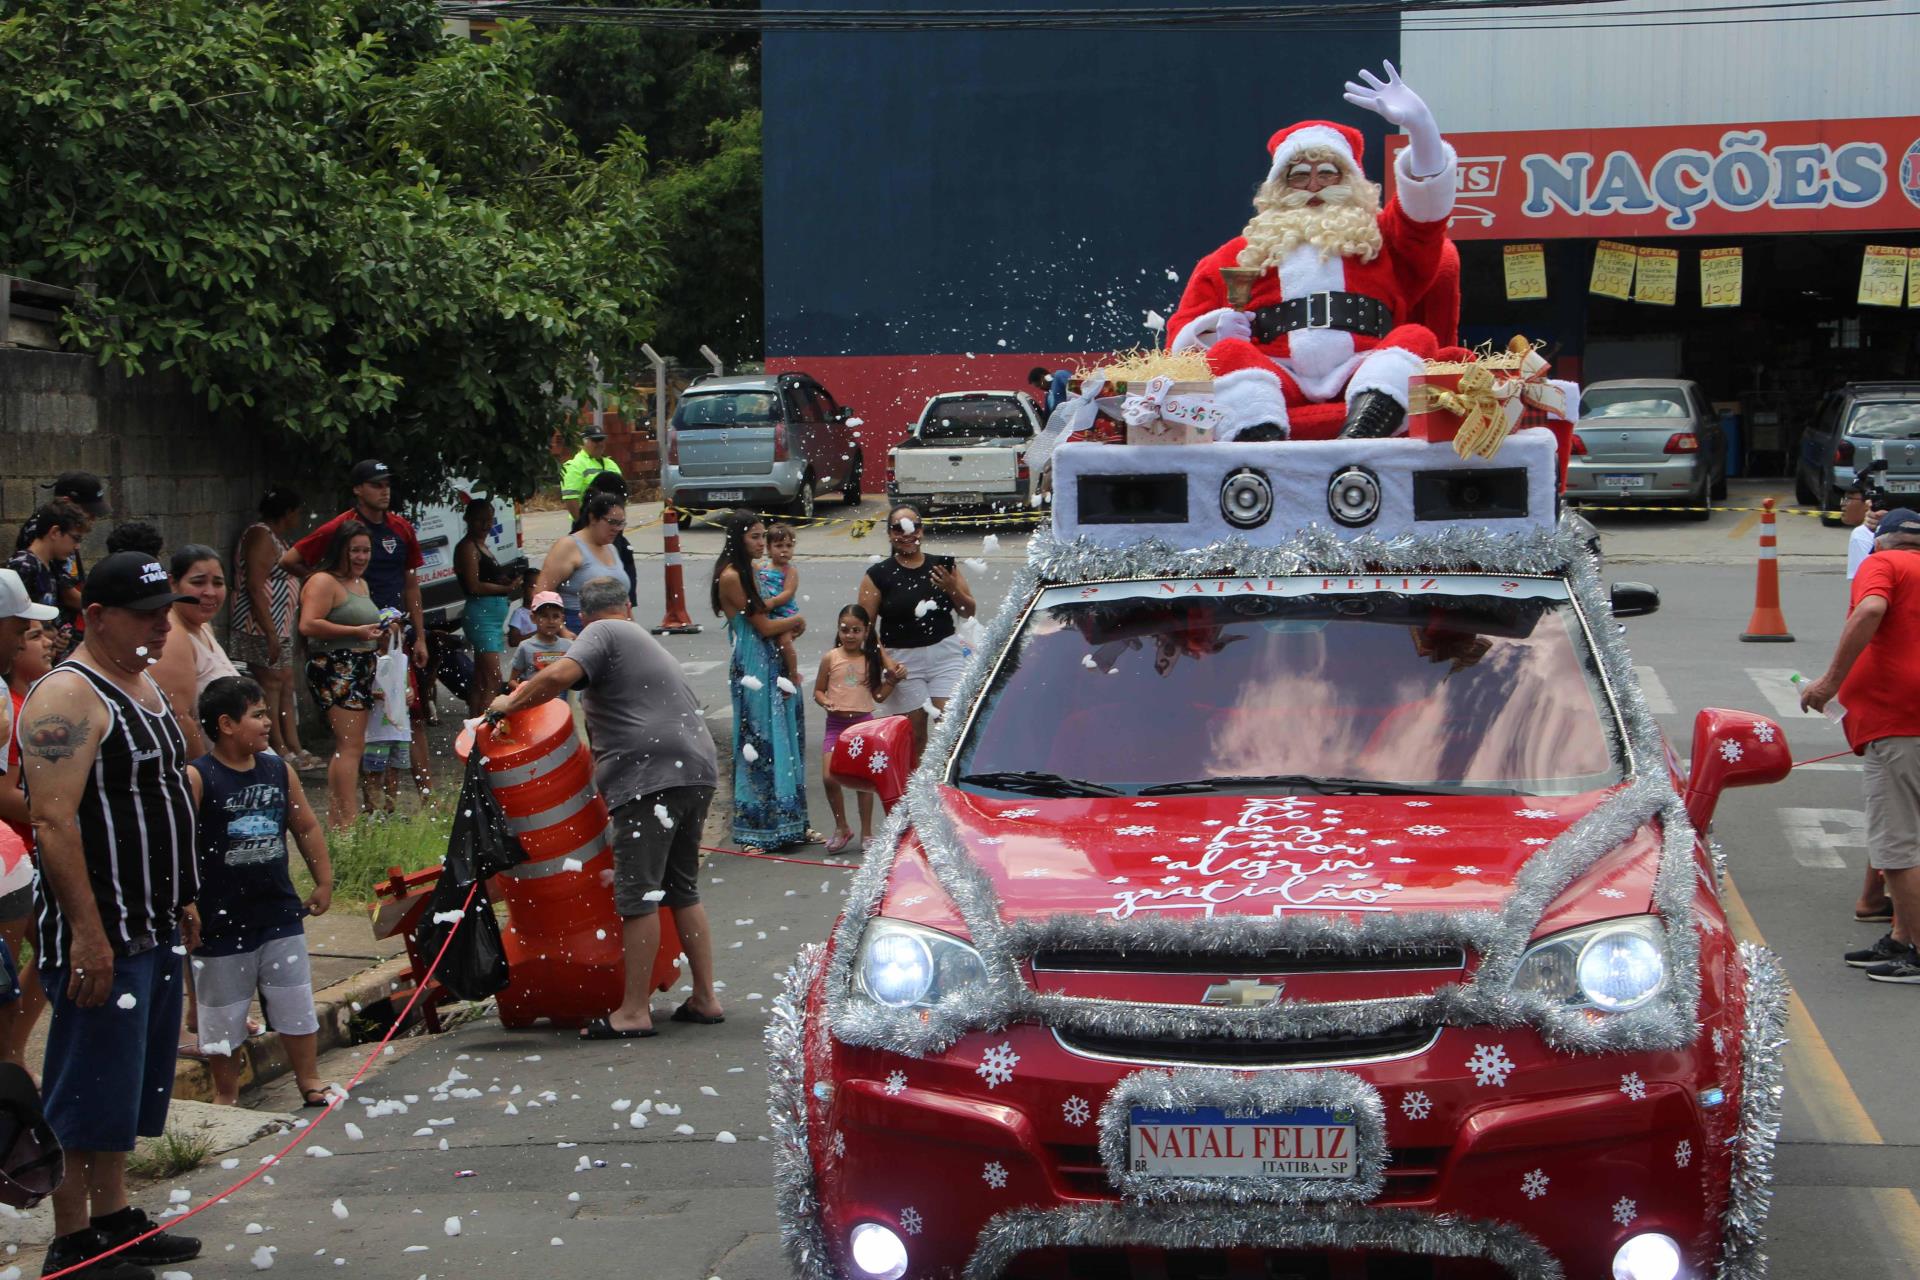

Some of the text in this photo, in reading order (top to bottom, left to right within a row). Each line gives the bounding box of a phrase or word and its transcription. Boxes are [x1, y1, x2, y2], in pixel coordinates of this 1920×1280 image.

[1521, 130, 1887, 230] NAÇÕES
[1503, 244, 1543, 253] OFERTA
[1598, 240, 1636, 253] OFERTA
[1639, 247, 1678, 257] OFERTA
[1702, 247, 1741, 257] OFERTA
[1867, 245, 1906, 256] OFERTA
[1158, 578, 1439, 594] NATAL FELIZ
[1213, 825, 1335, 842] paz
[1205, 839, 1366, 856] amor
[1166, 849, 1374, 878] alegria
[1112, 876, 1390, 921] gratidão
[1138, 1126, 1348, 1158] NATAL FELIZ
[1135, 1160, 1147, 1172] BR
[1262, 1161, 1319, 1173] ITATIBA
[1331, 1161, 1348, 1173] SP
